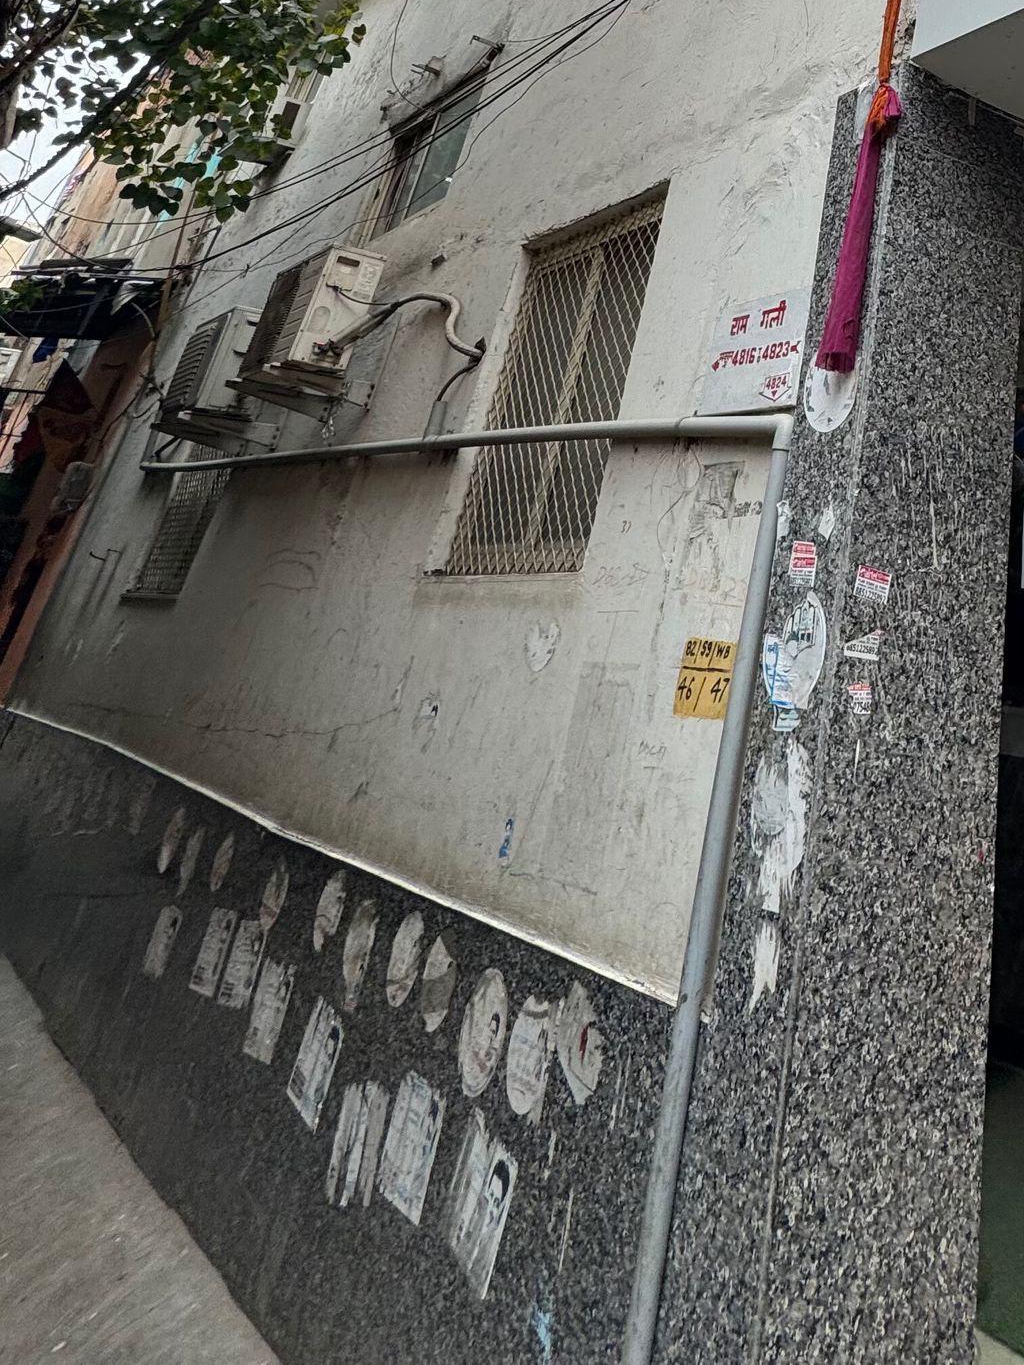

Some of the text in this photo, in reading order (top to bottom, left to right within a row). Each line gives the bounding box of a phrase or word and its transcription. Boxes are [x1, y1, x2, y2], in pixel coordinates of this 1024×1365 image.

[730, 299, 787, 336] राम गली
[732, 347, 756, 366] 4816
[762, 341, 790, 361] 4823
